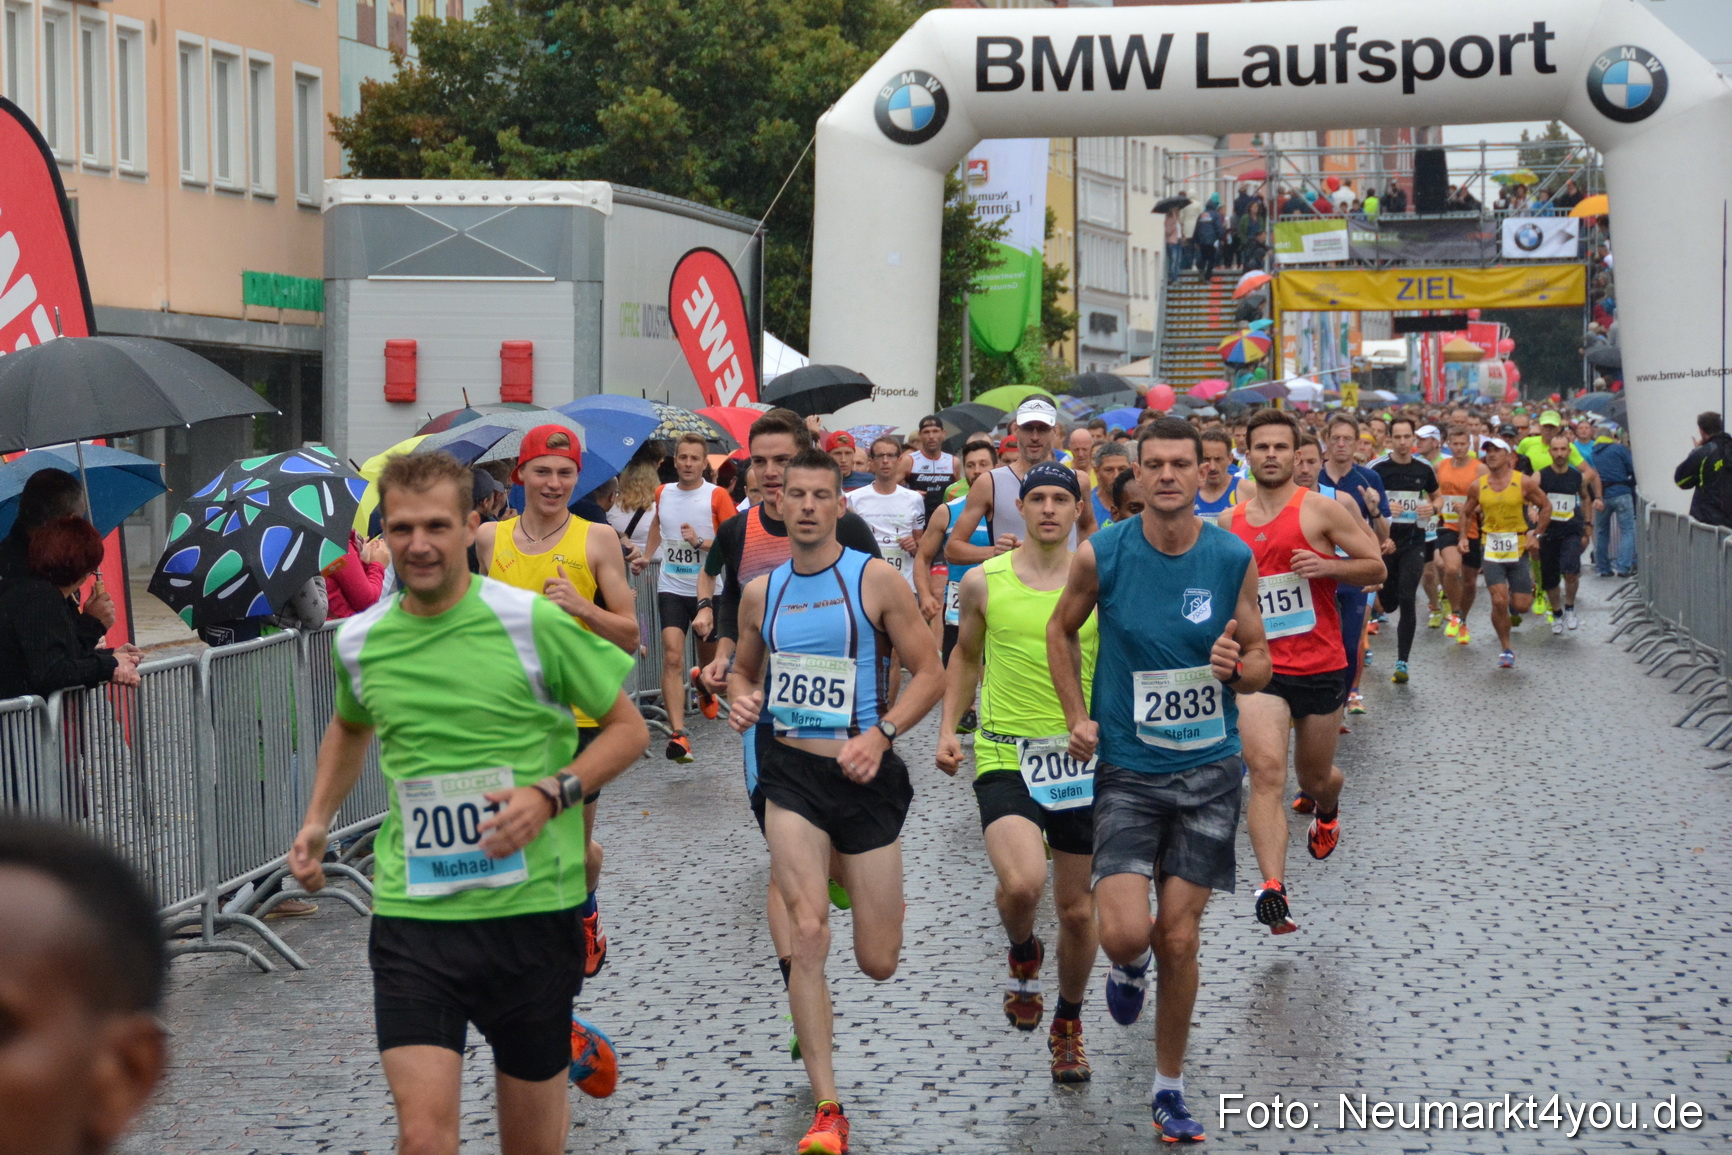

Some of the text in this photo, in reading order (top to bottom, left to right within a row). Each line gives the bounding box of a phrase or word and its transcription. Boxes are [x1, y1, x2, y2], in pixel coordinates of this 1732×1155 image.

[976, 21, 1557, 94] BMW Laufsport
[1595, 46, 1662, 73] BMW
[880, 71, 941, 99] BMW
[1396, 277, 1466, 301] ZIEL
[916, 473, 950, 483] Energizer
[1556, 501, 1568, 511] 14
[1492, 540, 1512, 551] 319
[667, 548, 700, 563] 2481
[1266, 617, 1286, 628] Tom
[806, 657, 848, 671] BOCK
[776, 672, 846, 709] 2685
[1145, 685, 1216, 722] 2833
[791, 711, 822, 727] Marco
[1164, 728, 1200, 740] Stefan
[442, 773, 502, 794] BOCK
[1049, 786, 1083, 800] Stefan
[431, 857, 494, 878] Michael
